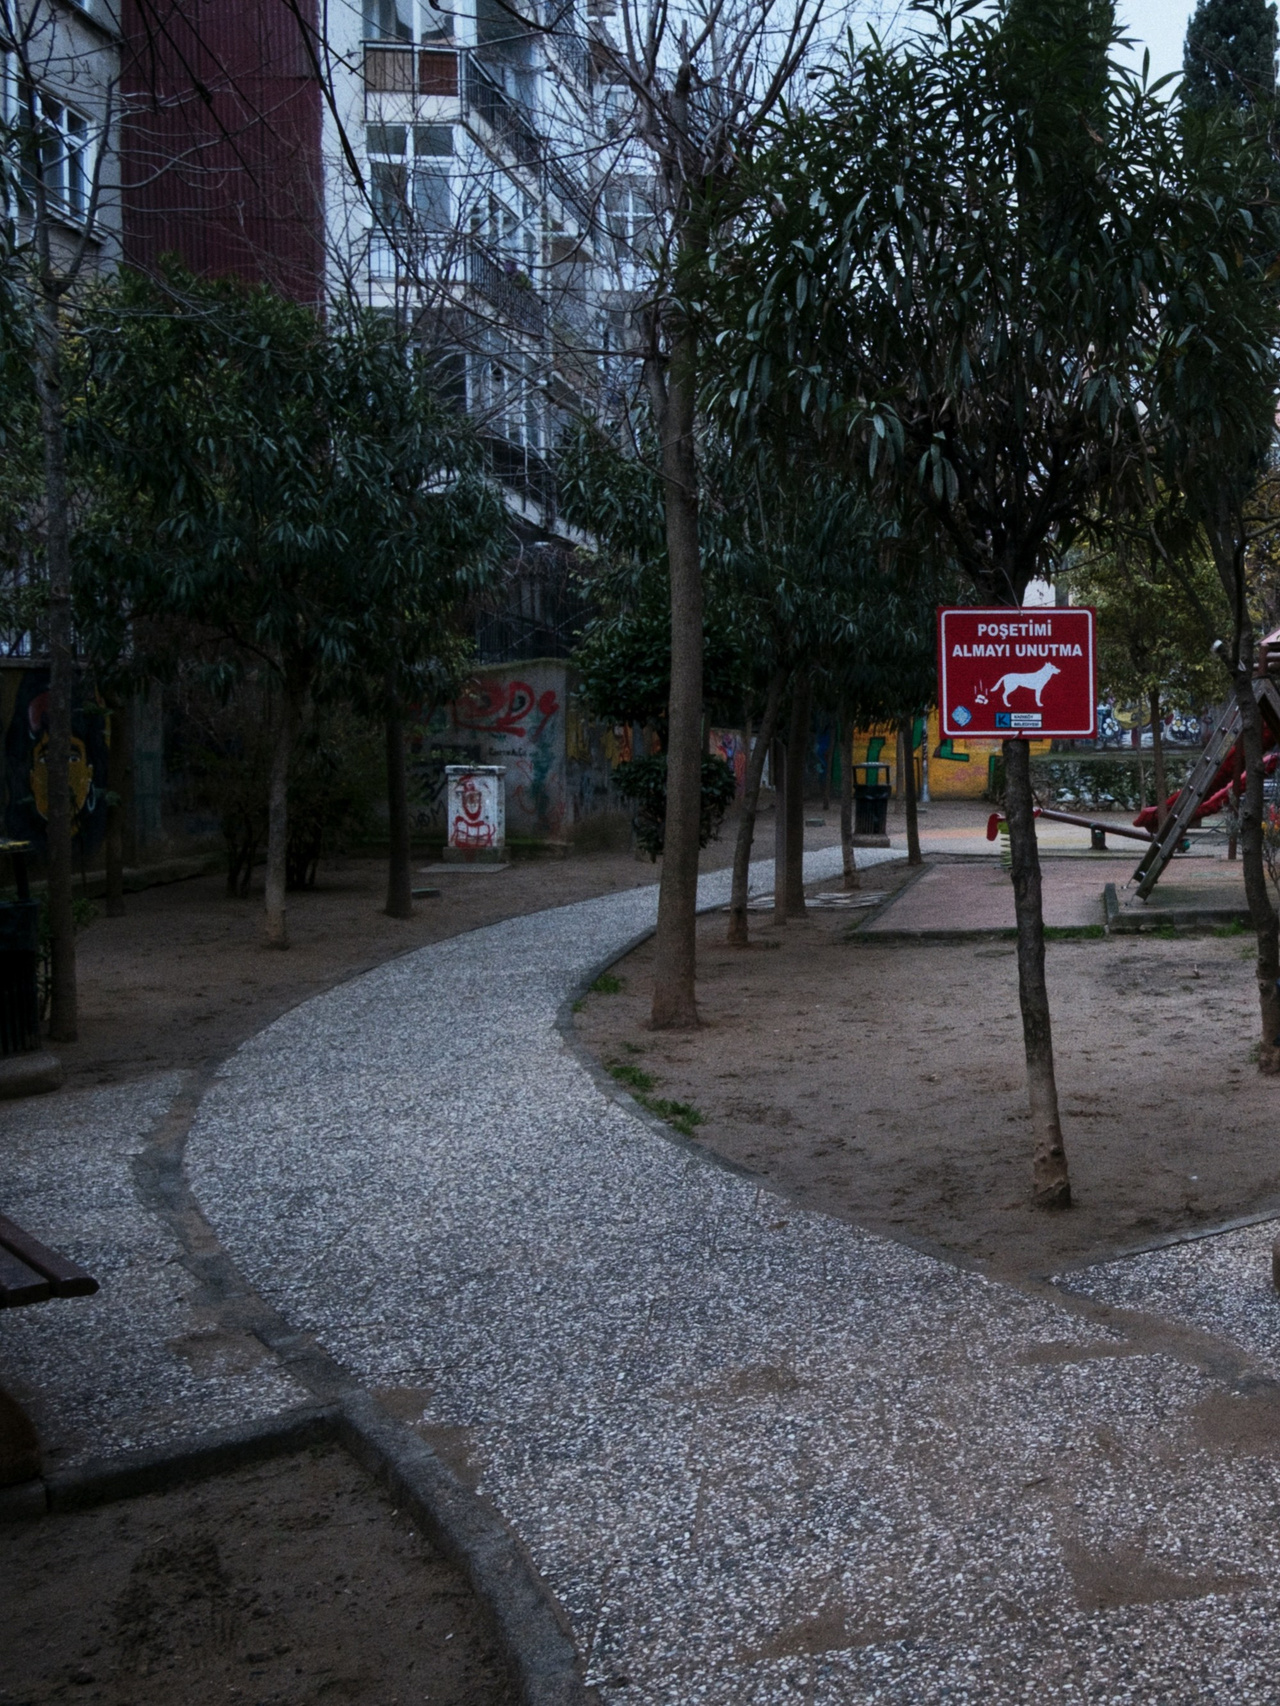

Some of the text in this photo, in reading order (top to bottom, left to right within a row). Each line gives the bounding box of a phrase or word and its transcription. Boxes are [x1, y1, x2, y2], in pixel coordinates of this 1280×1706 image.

[977, 619, 1052, 640] POŞETİMİ
[952, 643, 1083, 657] ALMAYI UNUTMA
